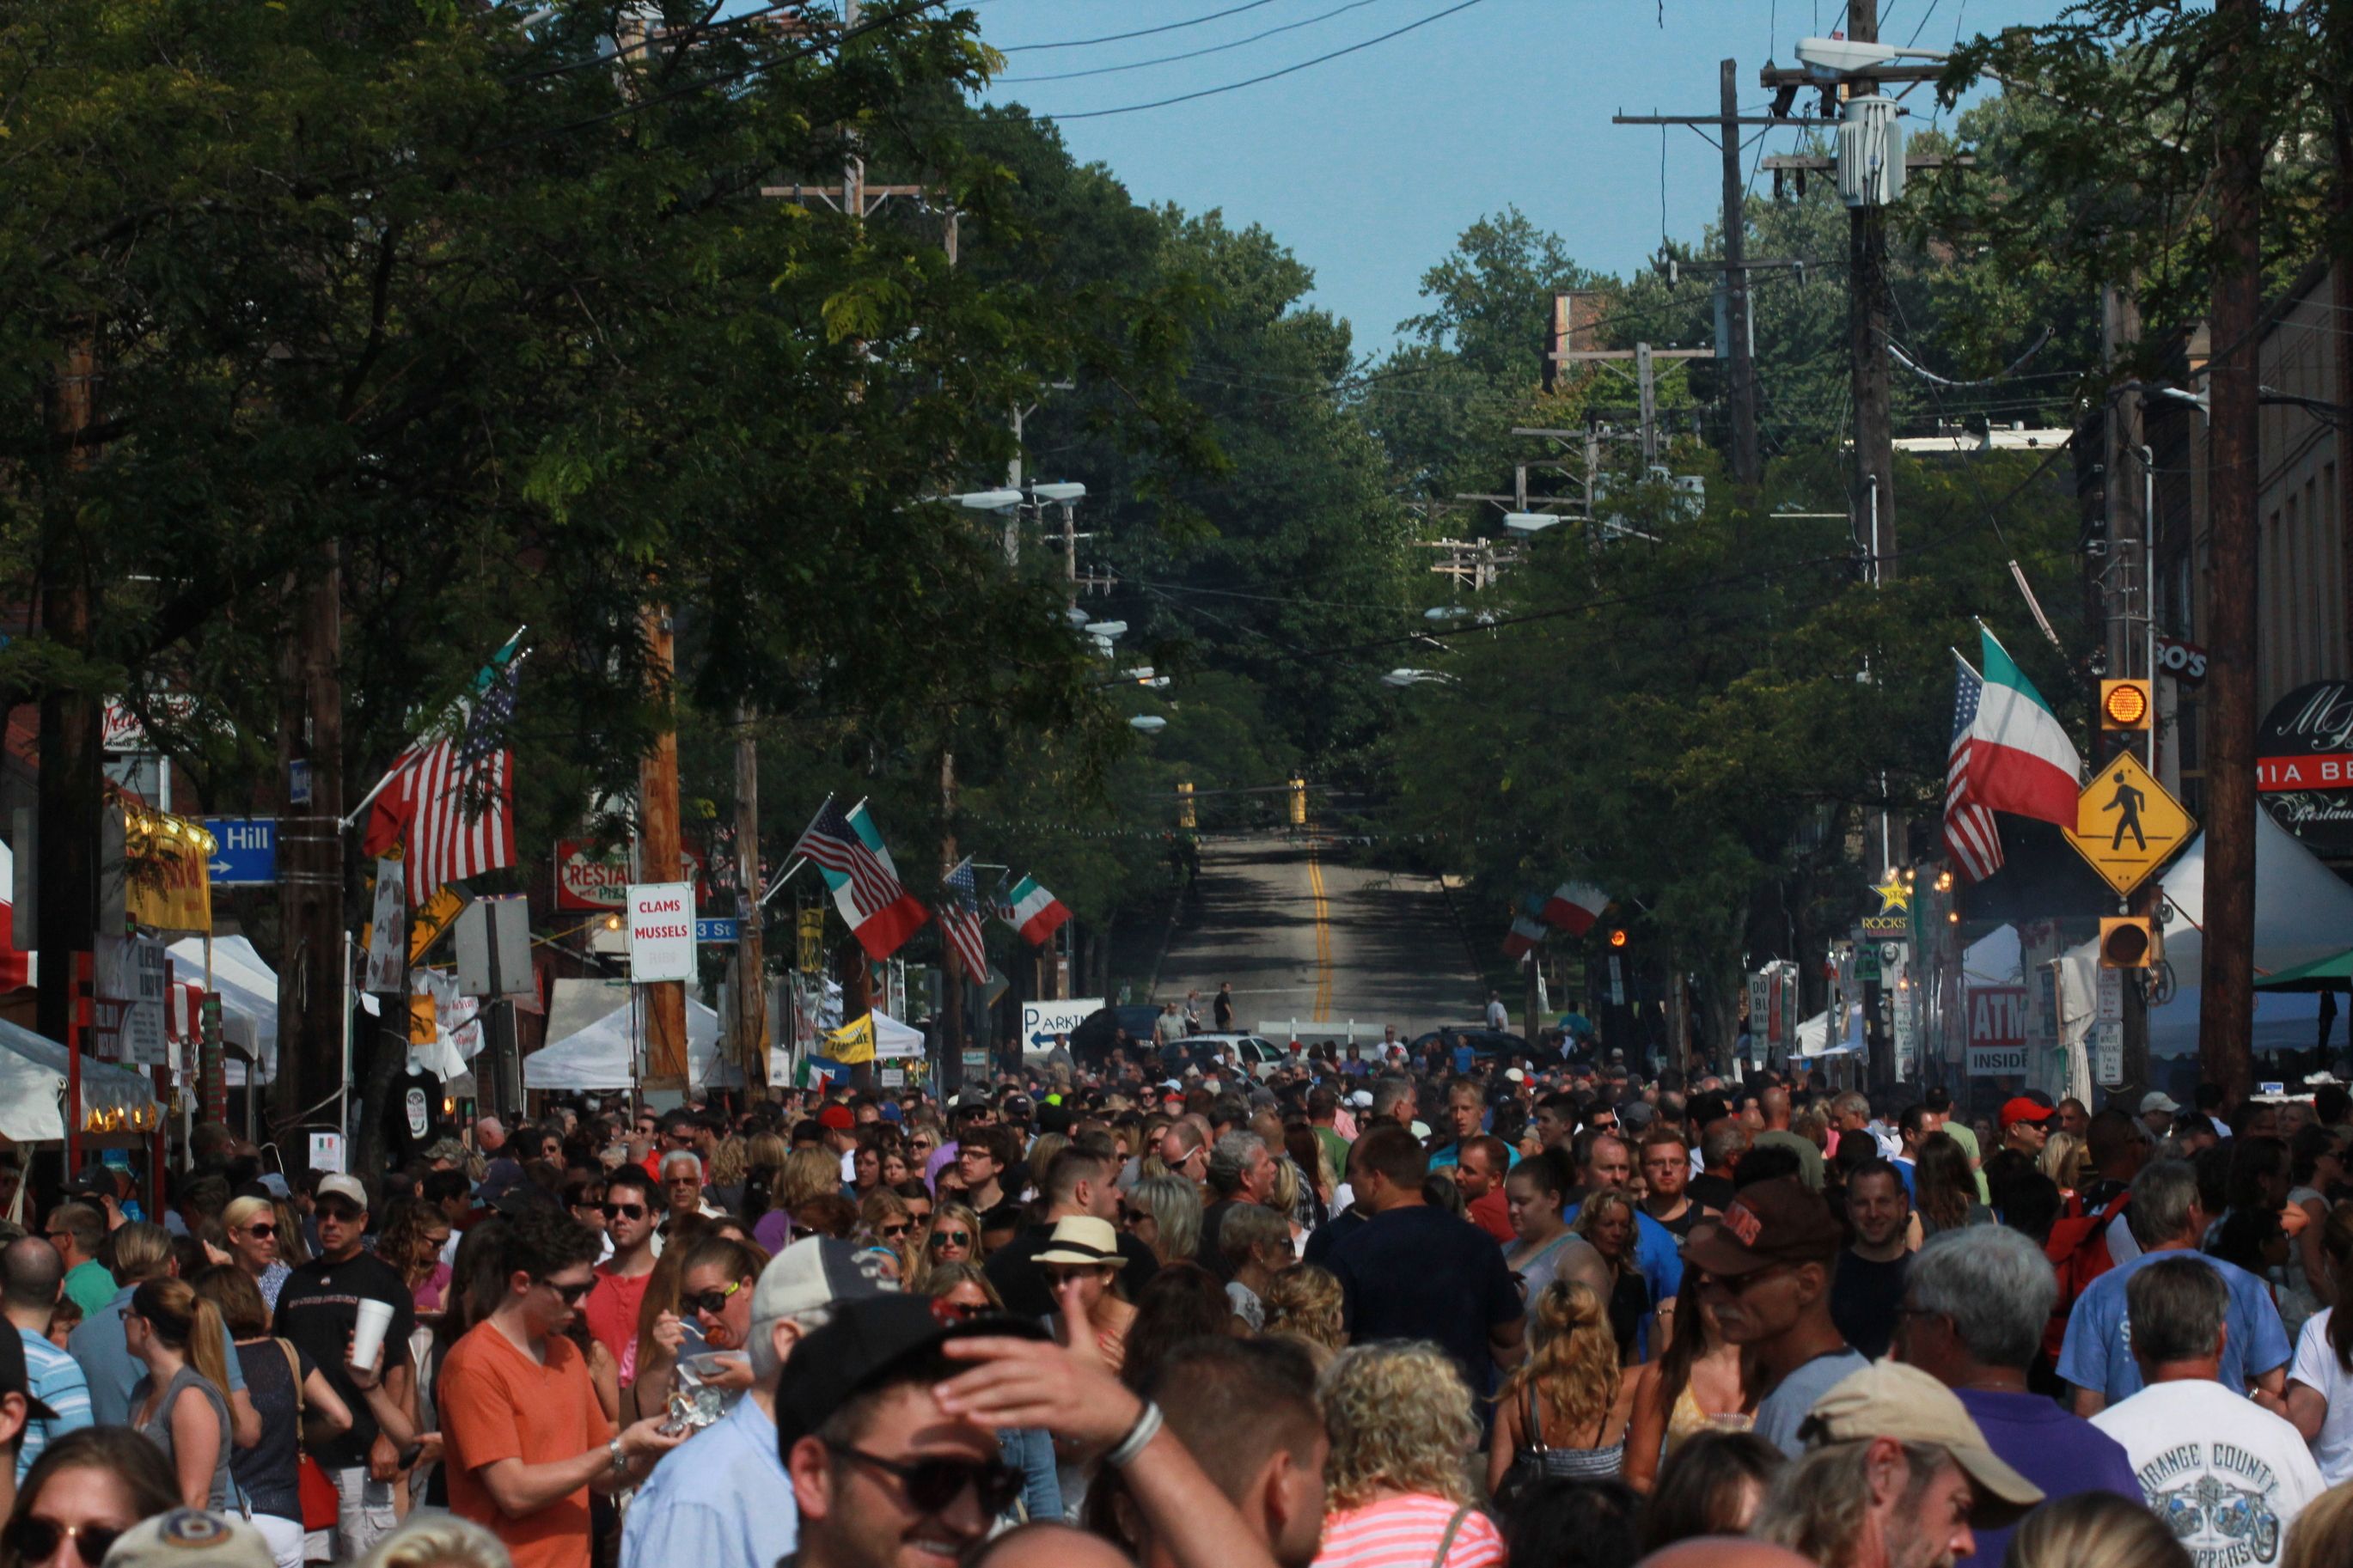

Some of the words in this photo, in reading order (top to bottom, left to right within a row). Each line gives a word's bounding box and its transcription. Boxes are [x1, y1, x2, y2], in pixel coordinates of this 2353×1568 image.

[2155, 642, 2207, 677] BO'S
[227, 827, 268, 850] Hill
[570, 863, 691, 886] RESTAT
[599, 886, 626, 900] PIZZ
[639, 900, 681, 913] CLAMS
[635, 925, 688, 939] MUSSELS
[697, 923, 706, 937] 3
[713, 923, 730, 936] St
[1861, 917, 1907, 929] ROCKS
[1755, 998, 1767, 1010] BL
[1024, 1009, 1088, 1033] PARKI
[1754, 1014, 1767, 1024] DRI
[1973, 993, 2027, 1040] ATM
[2213, 1443, 2278, 1493] COUNTY
[2190, 1541, 2251, 1568] PPERS
